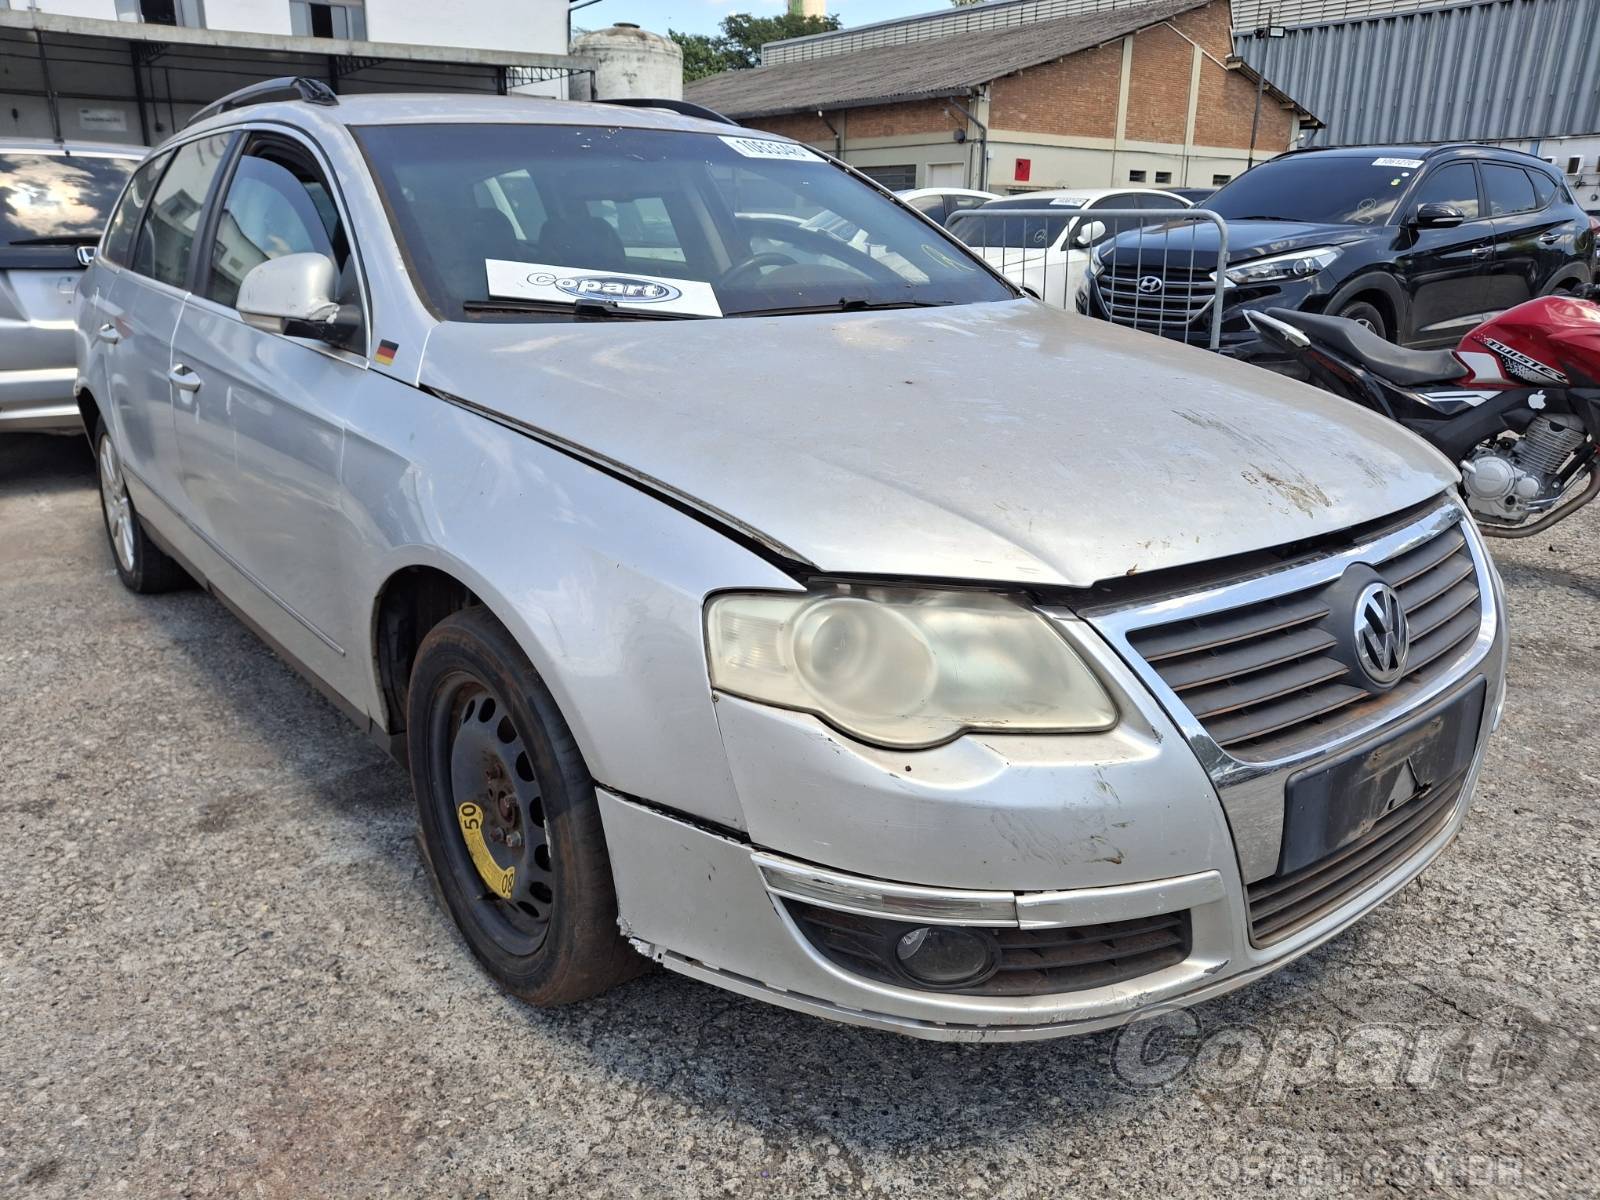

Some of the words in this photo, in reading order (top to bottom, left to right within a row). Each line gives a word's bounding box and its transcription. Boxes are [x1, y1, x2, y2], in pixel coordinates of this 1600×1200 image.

[527, 272, 660, 297] Copart
[1488, 340, 1567, 382] TWISTER
[461, 804, 479, 829] 50
